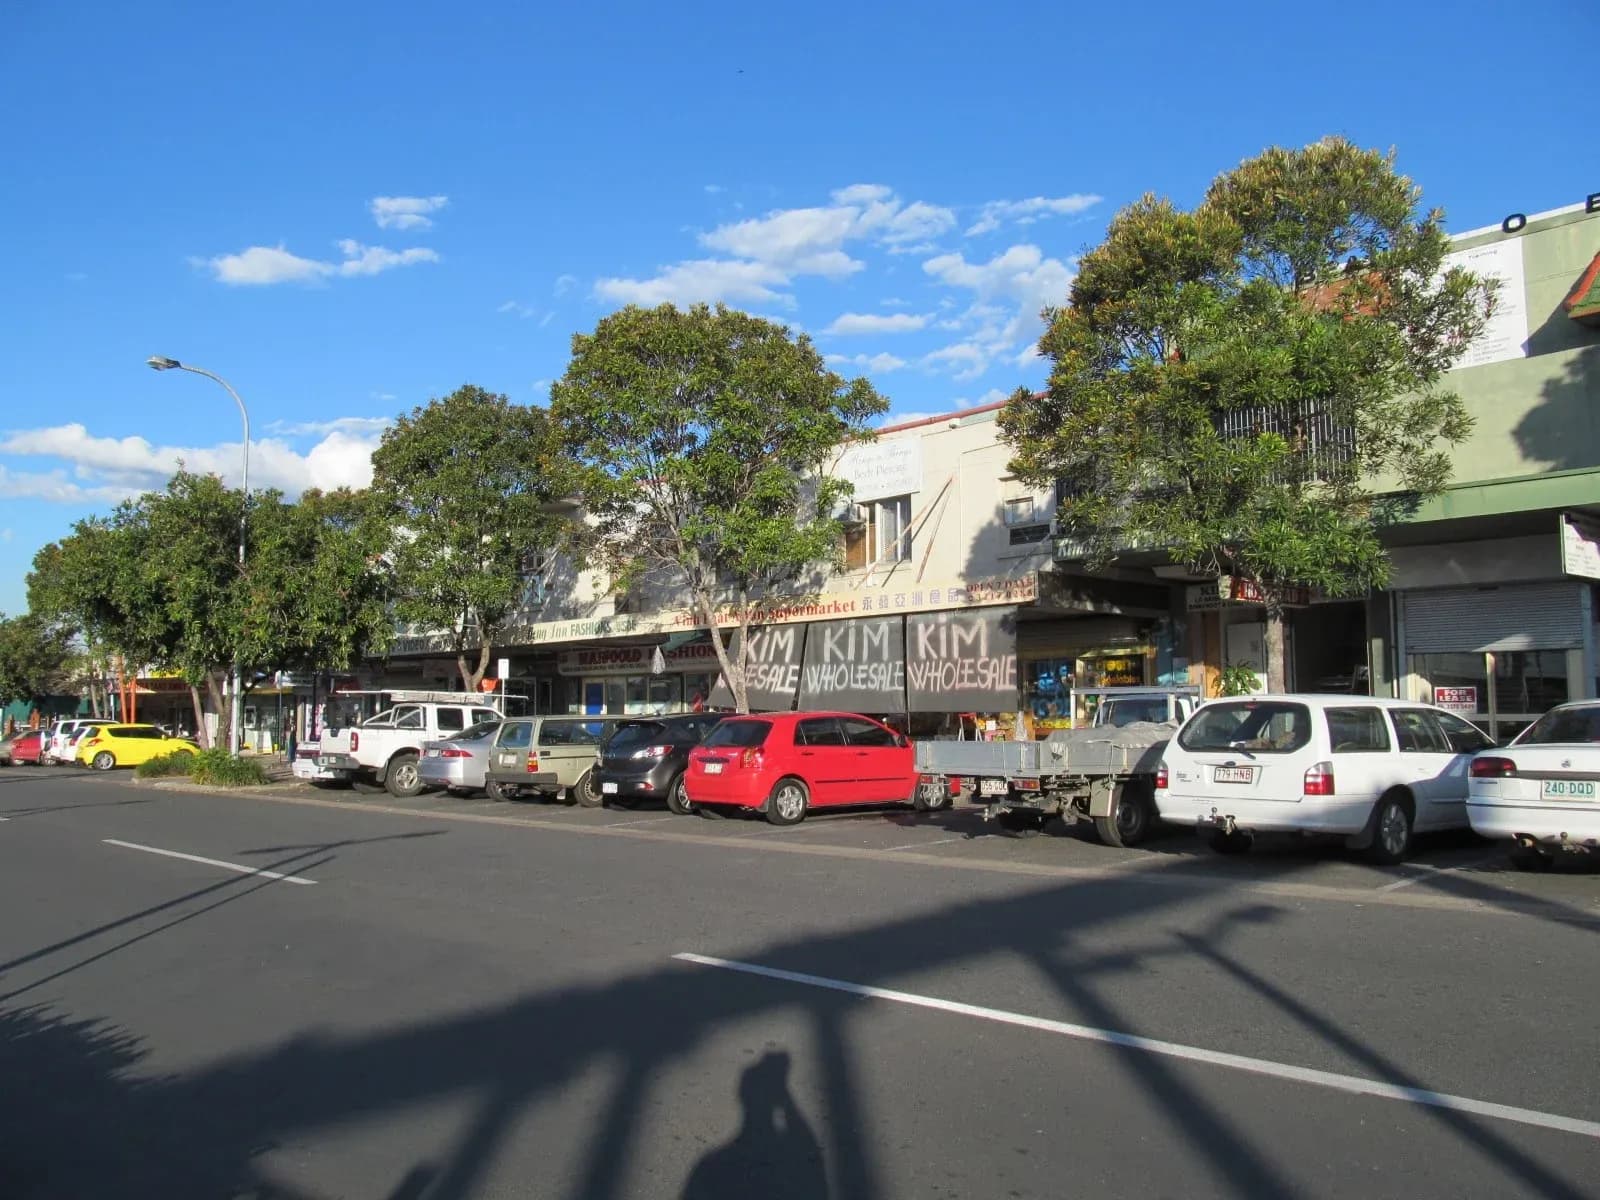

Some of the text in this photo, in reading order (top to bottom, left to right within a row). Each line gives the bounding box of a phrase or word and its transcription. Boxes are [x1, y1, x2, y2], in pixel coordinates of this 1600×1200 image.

[966, 581, 993, 593] OPEN
[806, 660, 904, 694] WHOLESALE
[907, 654, 1017, 694] WHOLESALE
